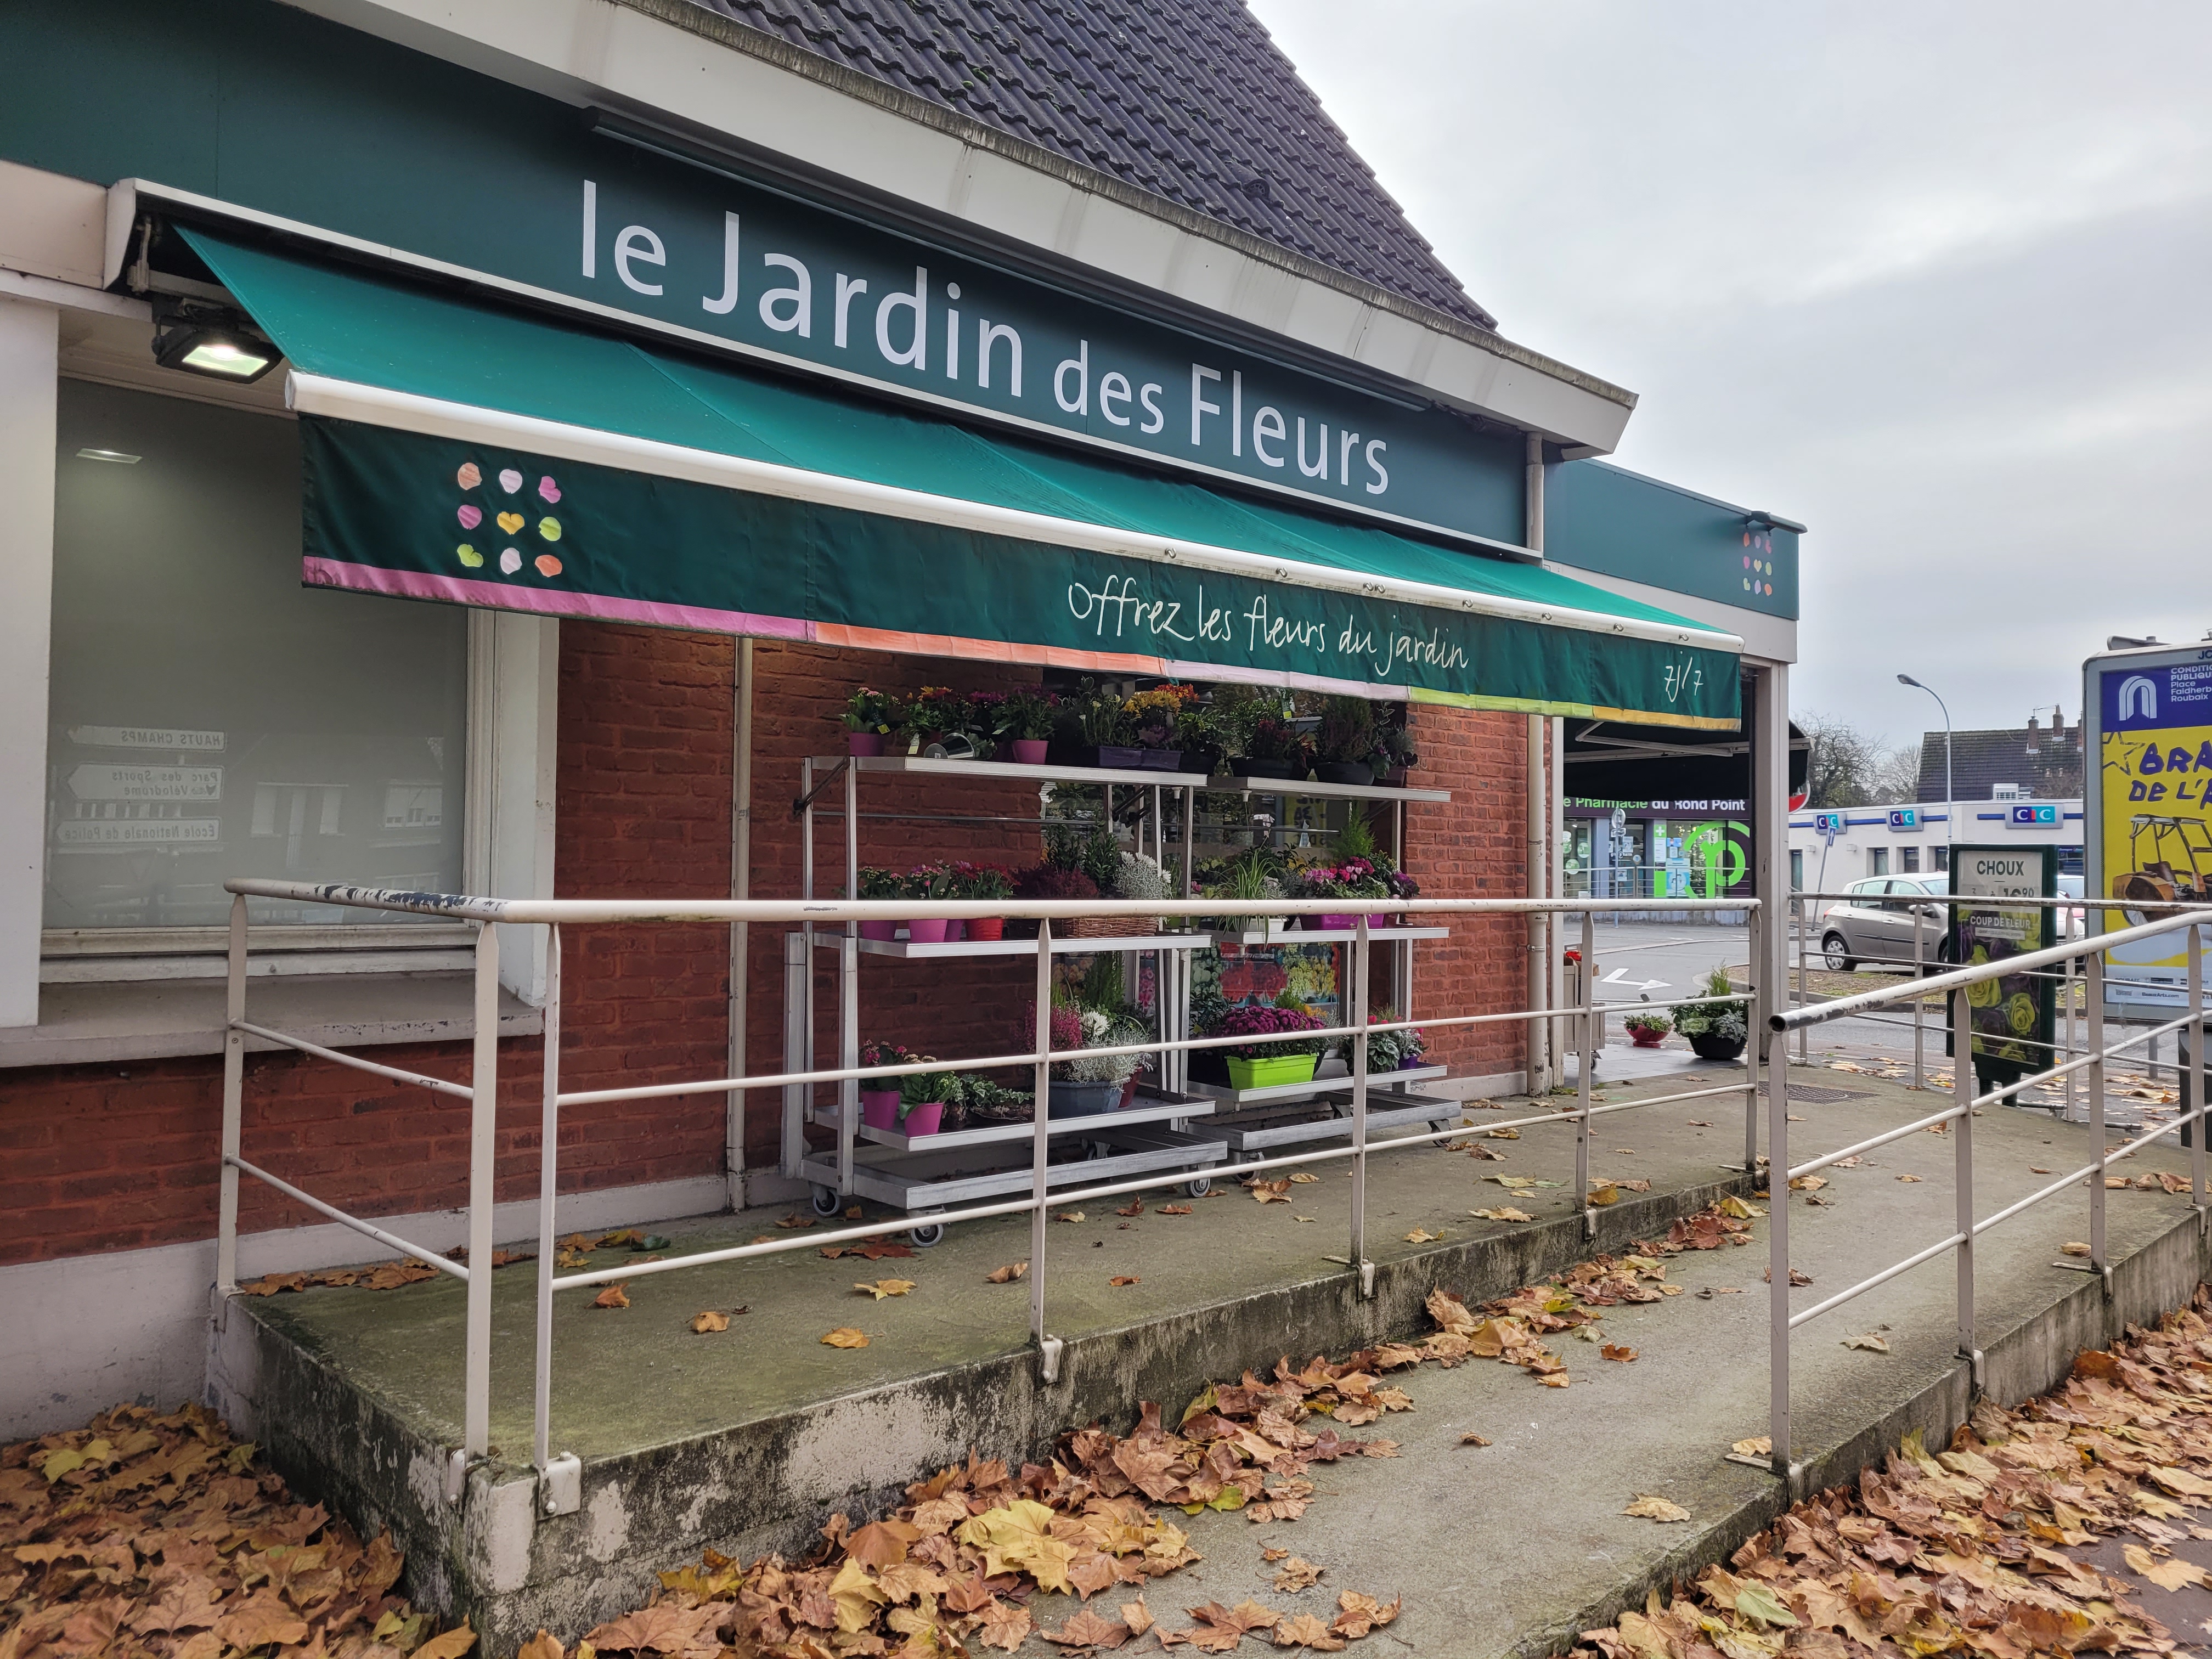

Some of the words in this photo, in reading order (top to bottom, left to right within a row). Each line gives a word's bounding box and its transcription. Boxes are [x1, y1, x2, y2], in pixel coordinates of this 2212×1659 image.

[582, 179, 666, 296] le
[702, 210, 1023, 397] Jardin
[1053, 339, 1164, 434] des
[1191, 362, 1389, 495] Fleurs
[1067, 574, 1195, 642] Offrez
[1198, 584, 1231, 642] les
[1243, 593, 1327, 652] fleurs
[1339, 613, 1378, 654] du
[1374, 613, 1470, 677] jardin
[2171, 672, 2212, 681] PUBLIQU
[2171, 686, 2212, 695] Faidherb
[2171, 693, 2209, 702] Roubaix
[1576, 798, 1648, 809] Pharmacie
[1712, 799, 1746, 811] Point
[1976, 860, 2024, 876] CHOUX
[1970, 916, 1993, 926] COUP
[1994, 918, 2005, 927] DE
[2006, 919, 2031, 929] FLEUR
